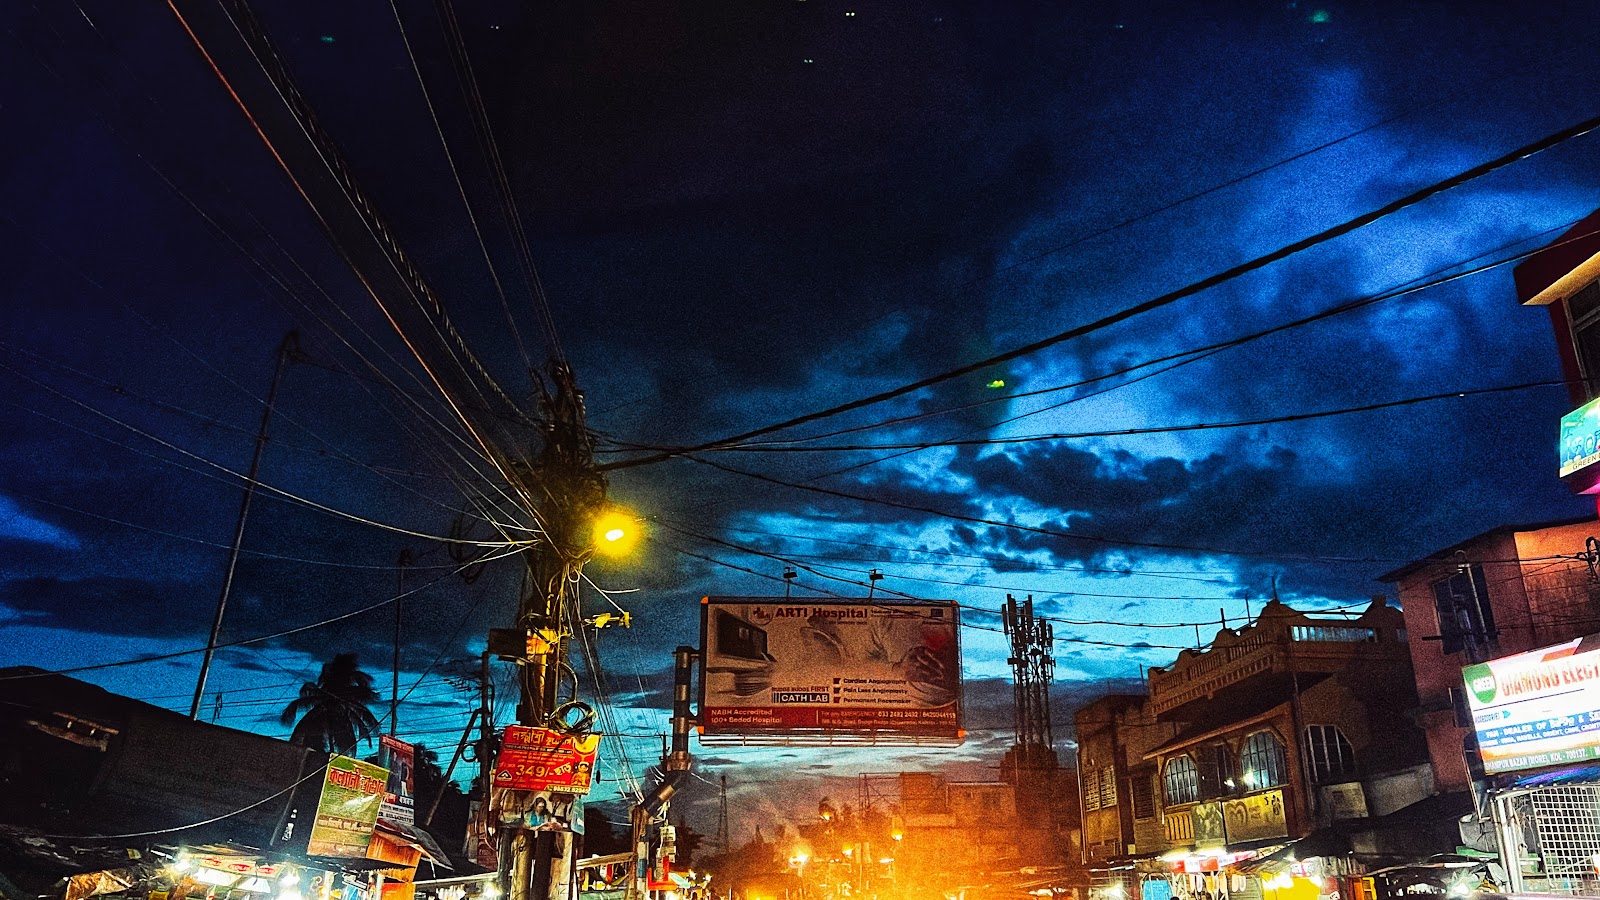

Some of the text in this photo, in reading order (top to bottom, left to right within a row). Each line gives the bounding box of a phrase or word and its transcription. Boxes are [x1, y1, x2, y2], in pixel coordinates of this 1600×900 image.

[1573, 455, 1597, 470] GREEN
[775, 607, 808, 618] ARTI
[812, 607, 868, 620] Hospital
[1501, 664, 1560, 697] DIAMOND
[781, 694, 829, 702] CATH LAB
[1503, 724, 1533, 736] DEALER
[1536, 721, 1547, 730] OF
[1509, 754, 1529, 766] BAZAR
[1550, 751, 1563, 761] KOL
[515, 764, 554, 777] 349/-
